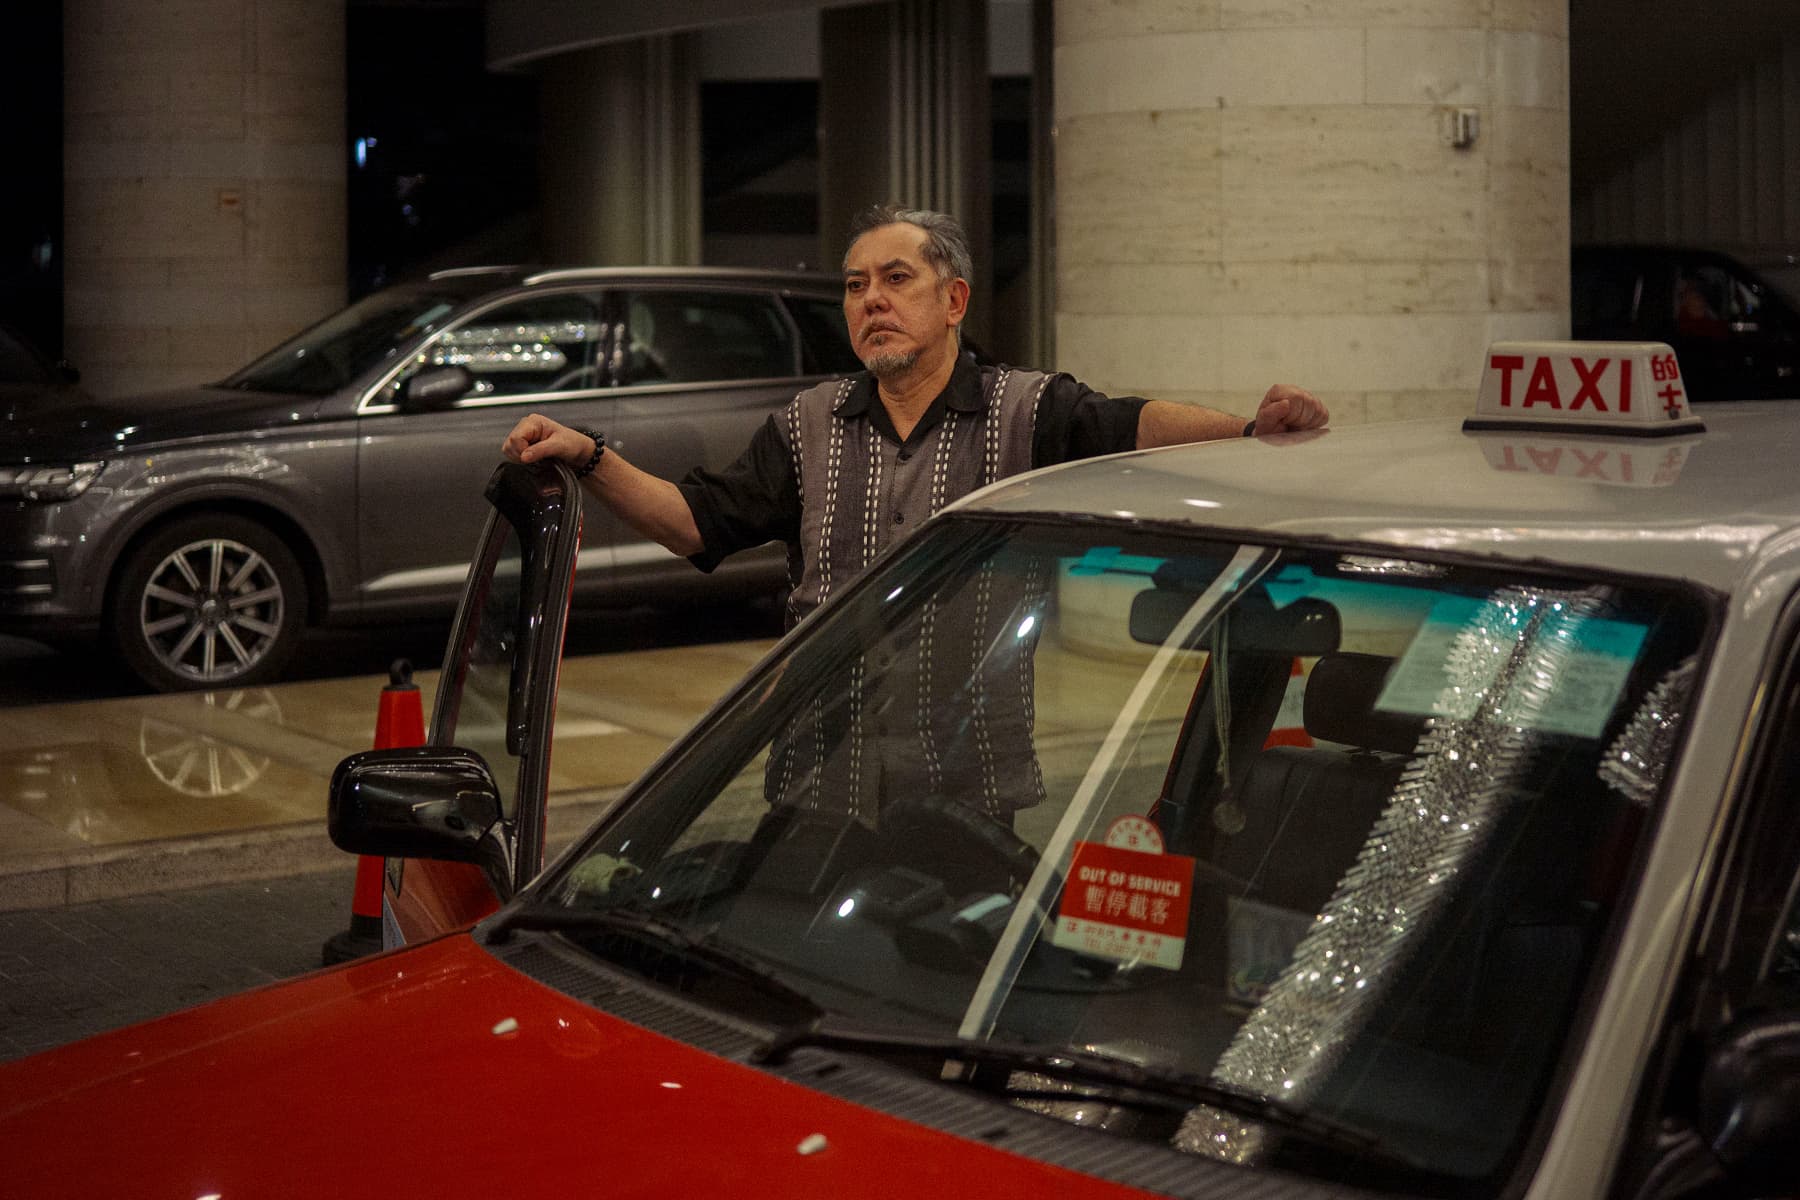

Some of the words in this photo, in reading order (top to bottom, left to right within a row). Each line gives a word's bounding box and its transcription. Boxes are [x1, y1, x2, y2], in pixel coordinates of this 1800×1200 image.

[1490, 354, 1632, 413] TAXI
[1651, 353, 1683, 413] 的士
[1079, 865, 1107, 884] OUT
[1108, 870, 1127, 887] OF
[1128, 874, 1182, 897] SERVICE
[1085, 884, 1170, 925] 暫停載客
